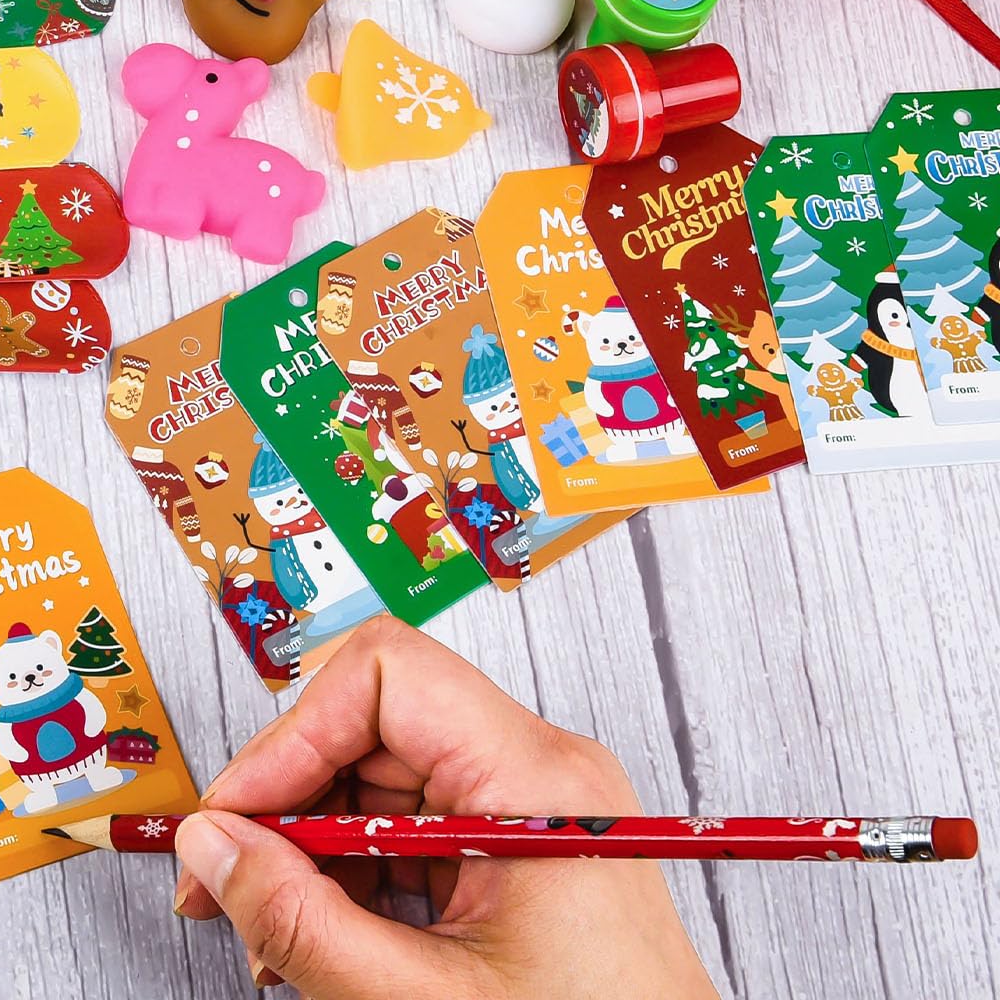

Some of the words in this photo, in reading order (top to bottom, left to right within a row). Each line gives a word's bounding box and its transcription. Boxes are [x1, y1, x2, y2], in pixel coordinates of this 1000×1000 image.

[638, 165, 744, 224] Merry
[621, 193, 748, 262] Christm
[516, 241, 606, 277] Chris
[373, 250, 466, 318] MERRY
[360, 265, 489, 356] CHRISTMA
[948, 384, 980, 395] From:
[148, 384, 235, 444] CHRIS
[825, 432, 857, 443] From:
[728, 443, 760, 461] From:
[565, 475, 599, 489] From:
[502, 536, 533, 558] From:
[407, 574, 438, 598] From:
[272, 635, 305, 659] From:
